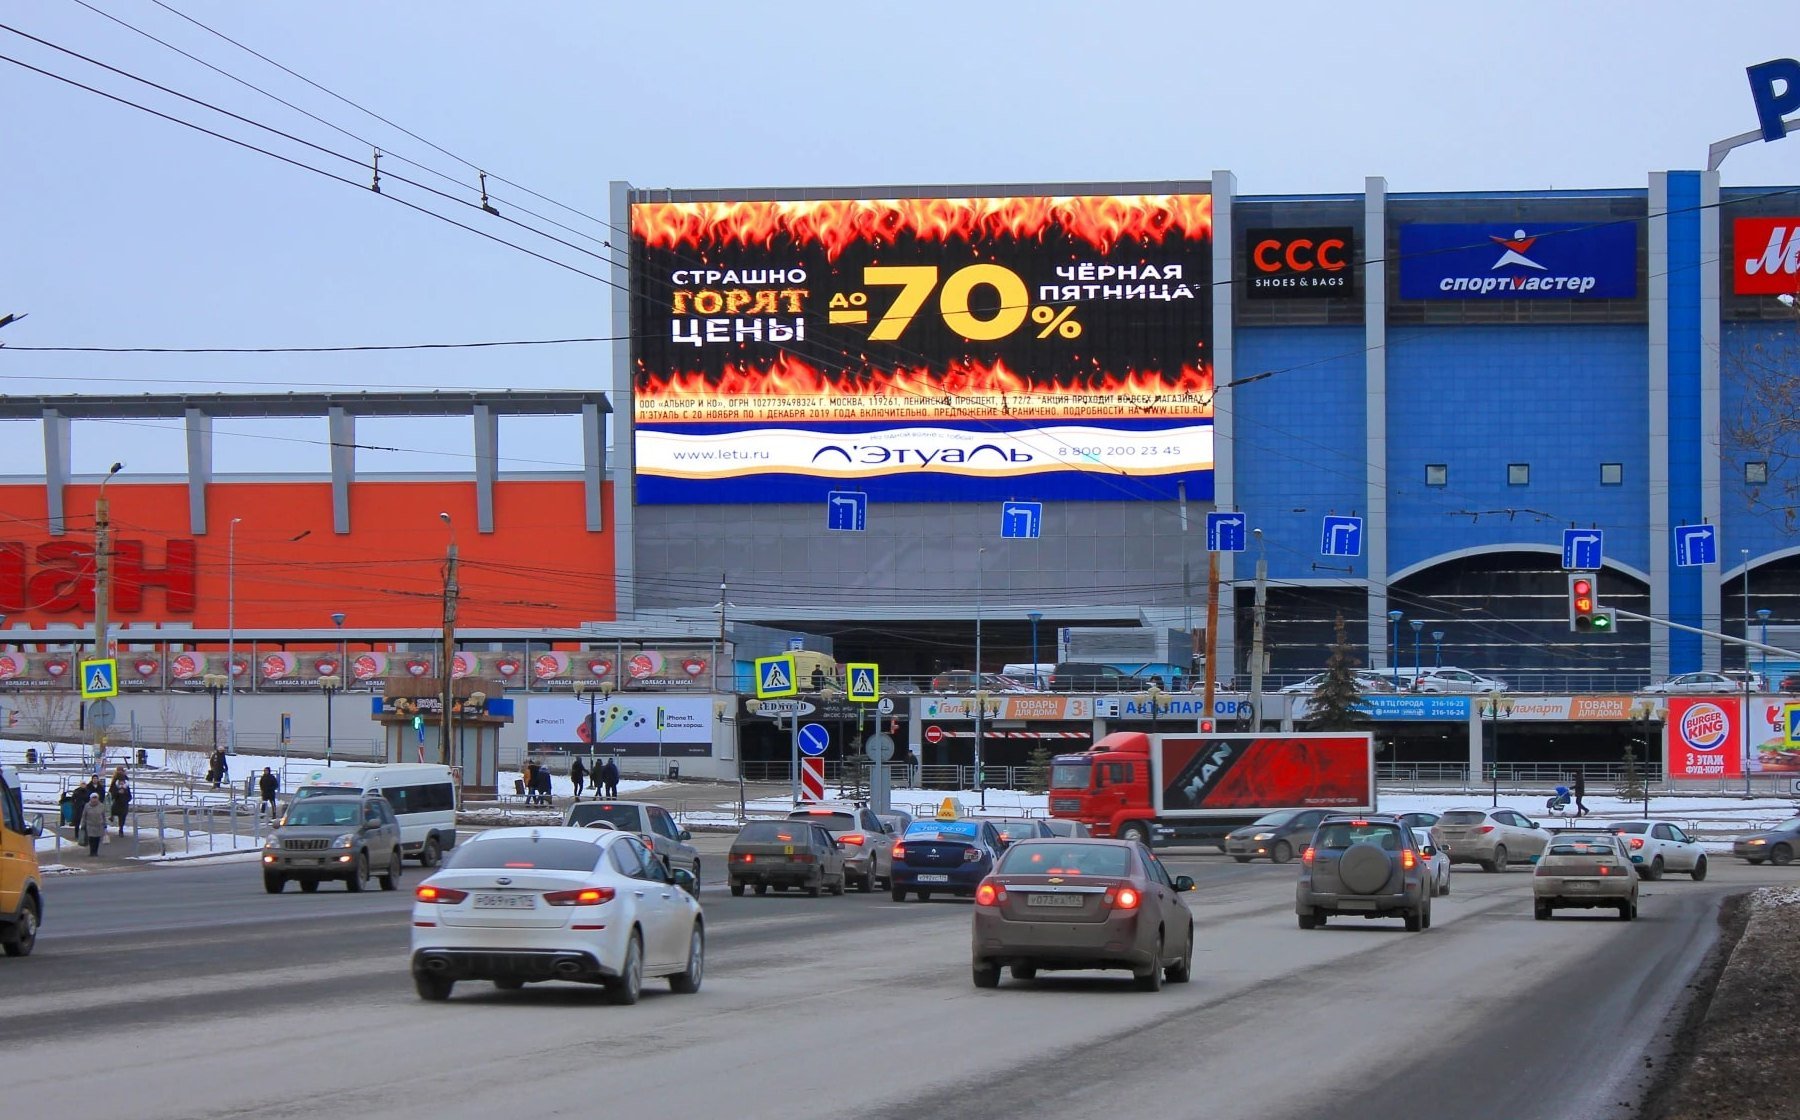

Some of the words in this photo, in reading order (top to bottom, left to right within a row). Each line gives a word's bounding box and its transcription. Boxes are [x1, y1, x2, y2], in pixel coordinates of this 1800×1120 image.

[1254, 239, 1345, 272] CCC
[672, 269, 807, 285] СТРАШНО
[1056, 263, 1182, 281] ЧЁРНАЯ
[1255, 278, 1296, 287] SHOES
[1299, 277, 1308, 287] &
[1312, 277, 1344, 286] BAGS
[1439, 274, 1596, 294] спортмастер
[672, 288, 809, 314] ГОРЯТ
[829, 292, 867, 308] ДО
[672, 317, 805, 347] ЦЕНЫ
[640, 400, 655, 408] ООО
[698, 399, 703, 408] И
[729, 399, 749, 407] ОГРН
[830, 398, 865, 407] МОСКВА,
[683, 411, 688, 419] С
[692, 410, 702, 418] 20
[706, 410, 739, 419] НОЯБРЯ
[743, 410, 754, 418] ПО
[767, 409, 805, 419] ДЕКАБРЯ
[809, 409, 830, 418] 2019
[834, 409, 856, 418] ГОДА
[934, 407, 999, 417] ПРЕДЛОЖЕНИЕ
[1063, 406, 1124, 415] ПОДРОБНОСТИ
[1128, 406, 1139, 414] НА
[673, 450, 770, 460] www.letu.ru
[1058, 447, 1067, 456] 8
[1072, 446, 1102, 456] 800
[1106, 446, 1136, 456] 200
[1141, 446, 1158, 455] 23
[1163, 446, 1181, 455] 45
[1015, 700, 1058, 709] ТОВАРЫ
[1072, 701, 1083, 716] 3
[1578, 700, 1623, 710] ТОВАРЫ
[1015, 708, 1034, 716] ДЛЯ
[1034, 708, 1058, 716] ДОМА
[1578, 709, 1596, 717] ДЛЯ
[1597, 709, 1623, 717] ДОМА
[1686, 712, 1722, 729] BURGER
[1688, 720, 1723, 740] KING
[1686, 753, 1694, 765] 3
[1697, 754, 1724, 765] ЭТАЖ
[1184, 742, 1232, 799] MAN
[1685, 765, 1724, 774] ФУД-КОРТ
